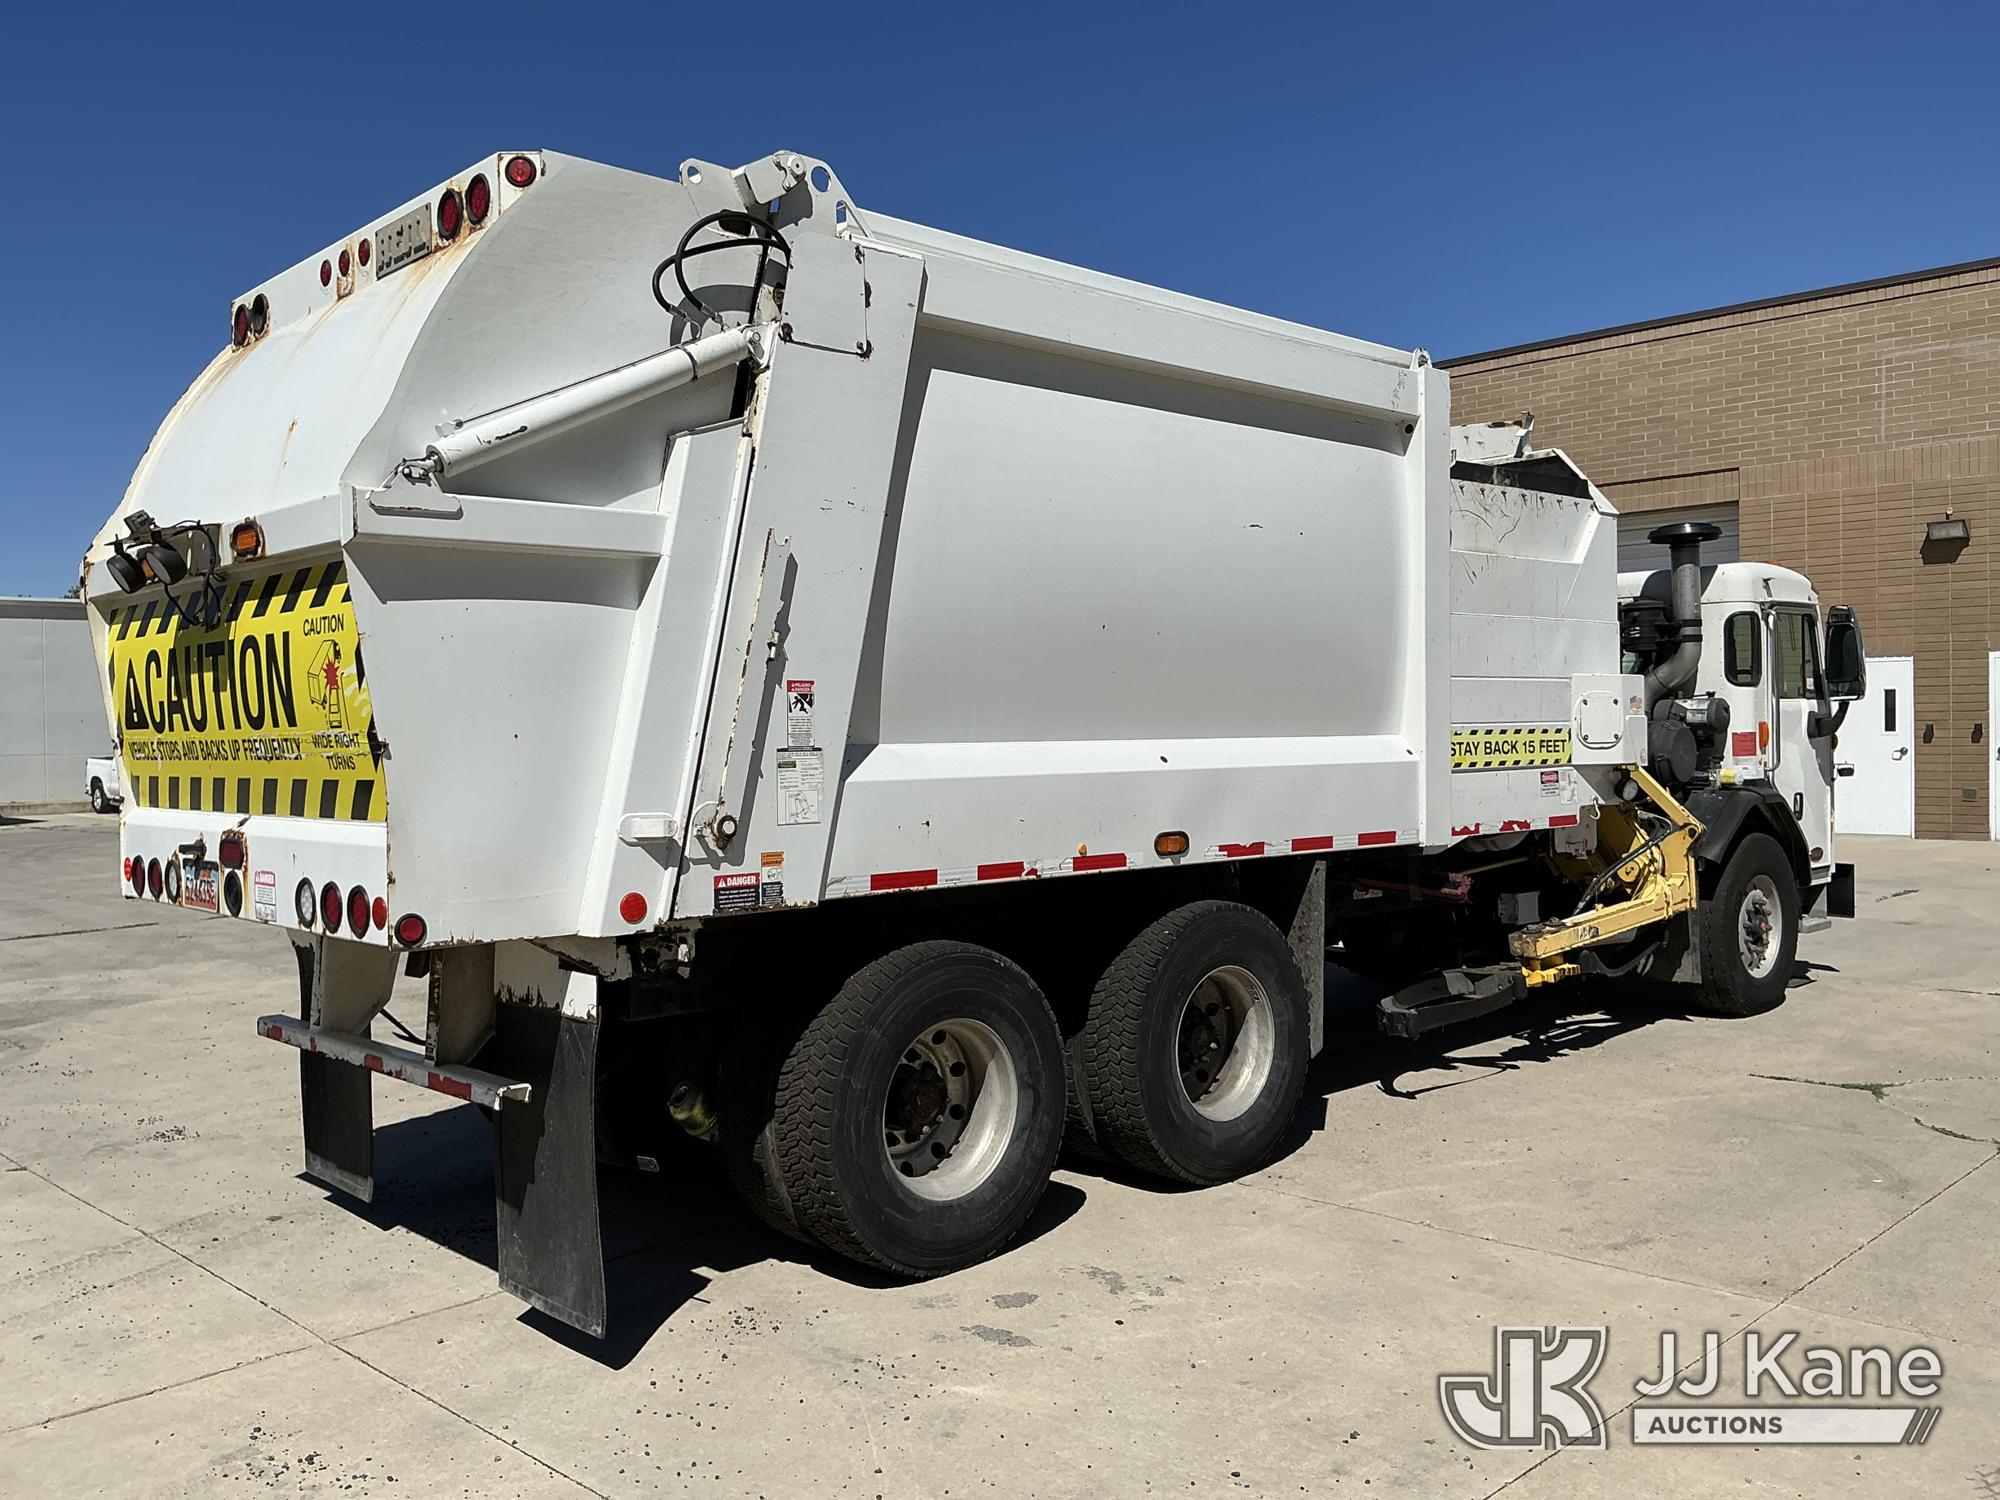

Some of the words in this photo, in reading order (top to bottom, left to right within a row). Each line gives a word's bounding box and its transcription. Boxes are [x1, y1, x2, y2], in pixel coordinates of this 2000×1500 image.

[303, 613, 344, 637] CAUTION
[145, 631, 298, 734] CAUTION
[156, 740, 182, 761] STOPS
[182, 740, 199, 761] AND
[199, 739, 228, 761] BACKS
[228, 739, 240, 761] UP
[312, 735, 334, 749] WIDE
[334, 733, 361, 749] RIGHT
[1451, 742, 1480, 757] STAY
[1484, 740, 1519, 755] BACK
[1523, 740, 1535, 754] 15
[1539, 739, 1567, 753] FEET
[326, 756, 355, 770] TURNS
[726, 876, 757, 887] DANGER
